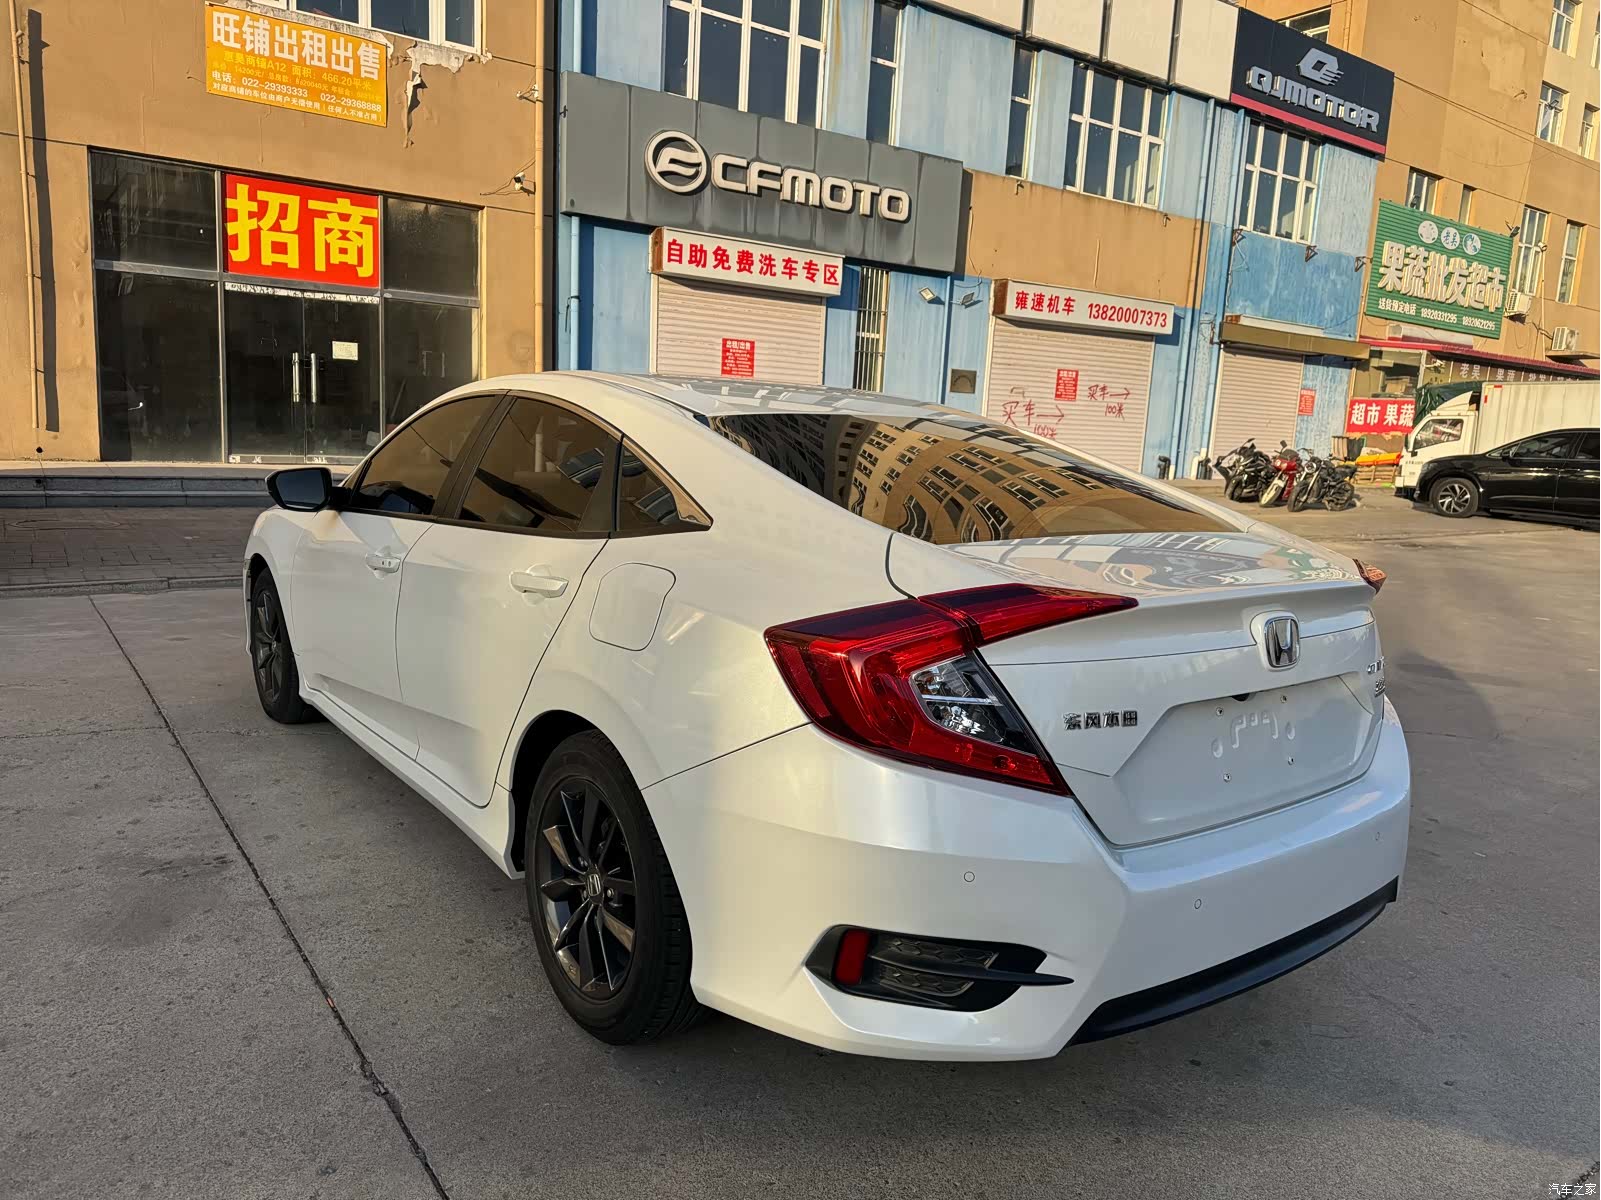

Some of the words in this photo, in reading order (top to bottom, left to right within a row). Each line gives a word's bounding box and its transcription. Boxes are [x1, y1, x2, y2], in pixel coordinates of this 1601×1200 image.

[212, 11, 380, 81] 旺铺出租出售
[242, 77, 308, 98] 022-29393333
[320, 92, 382, 112] 022-29368888
[1246, 65, 1380, 132] QJMOTOR
[711, 153, 911, 222] CFMOTO
[225, 182, 378, 278] 招商
[667, 238, 840, 286] 自助免费洗车专区
[1378, 240, 1506, 313] 果蔬批发超市
[1015, 290, 1076, 315] 雍速机车
[1087, 303, 1168, 328] 13820007373
[1087, 384, 1109, 400] 买车
[1105, 402, 1125, 420] 100米
[1002, 400, 1036, 427] 买车
[1350, 402, 1381, 426] 超市
[1383, 403, 1415, 427] 果蔬
[1063, 710, 1138, 730] 东风本田
